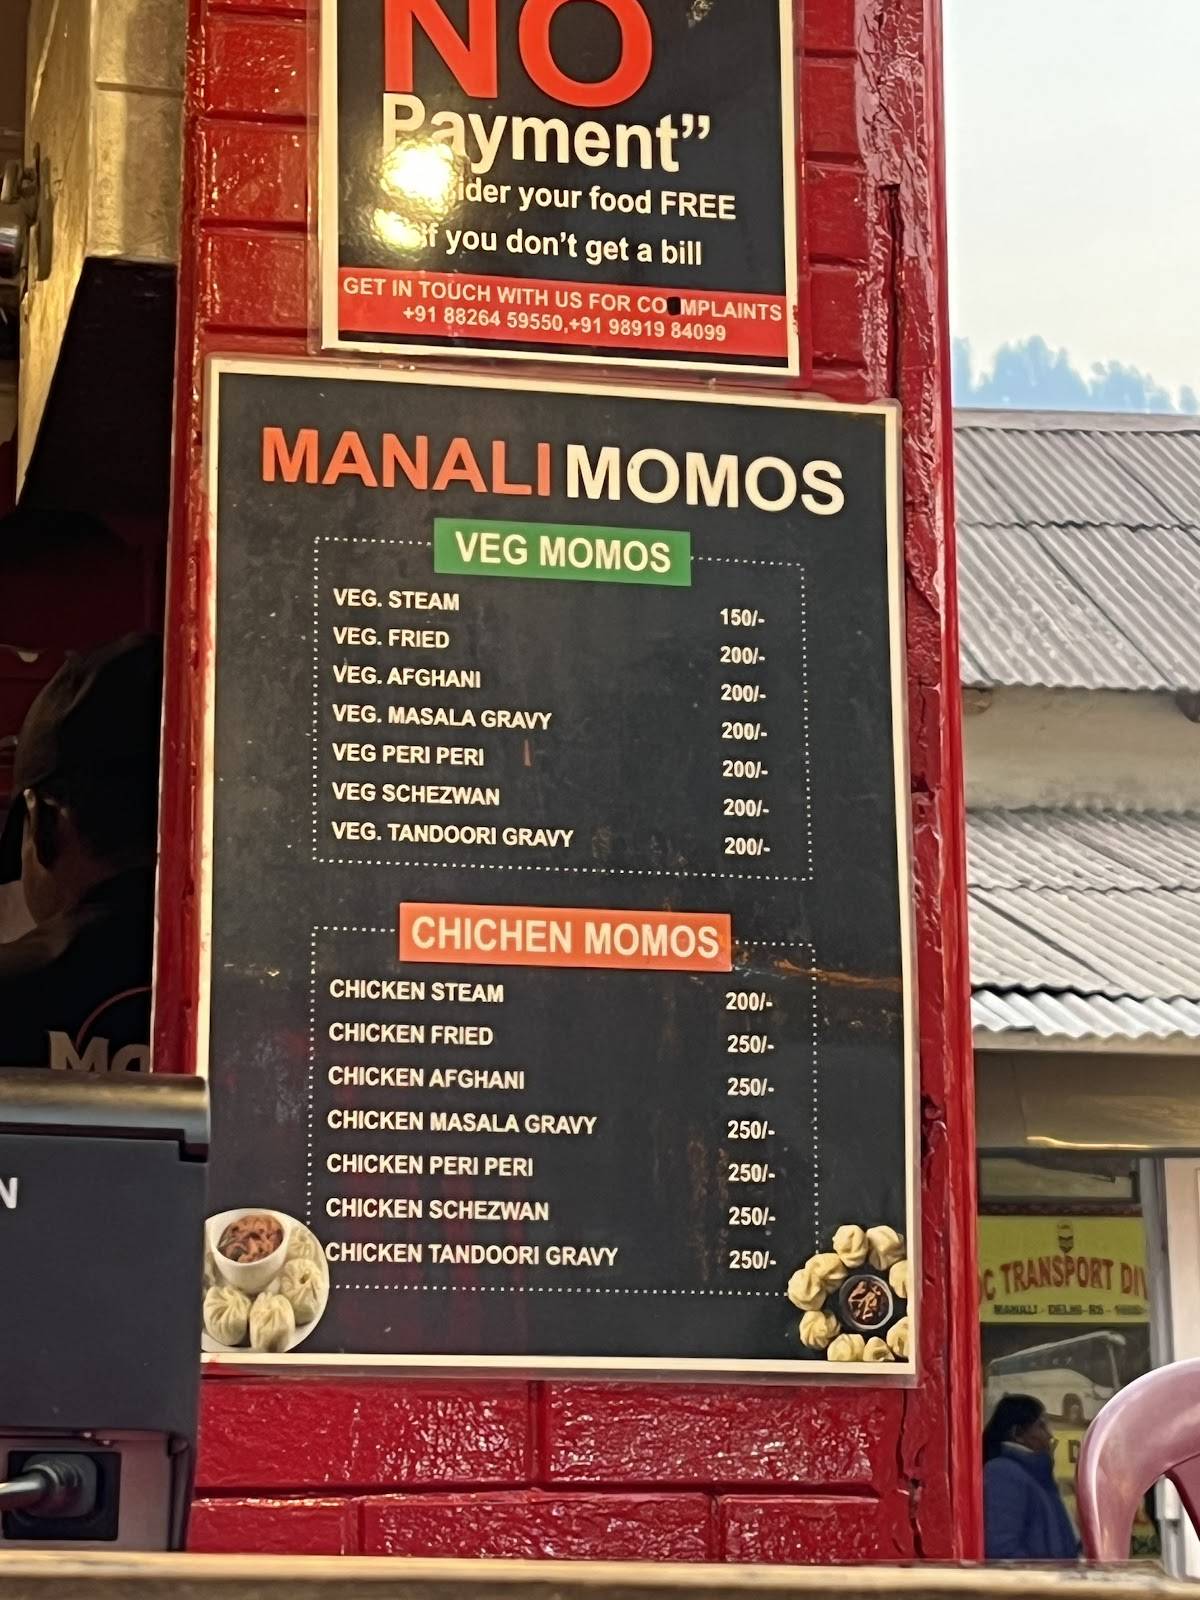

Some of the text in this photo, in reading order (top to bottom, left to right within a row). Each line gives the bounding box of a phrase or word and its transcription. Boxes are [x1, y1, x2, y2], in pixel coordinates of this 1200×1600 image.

[383, 0, 653, 107] NO
[458, 177, 737, 220] ider your food FREE
[445, 229, 497, 255] you
[585, 237, 630, 266] get
[636, 242, 653, 263] a
[661, 238, 702, 266] bill
[343, 276, 386, 297] GET
[392, 277, 412, 298] IN
[420, 280, 492, 302] TOUCH
[496, 285, 549, 307] WITH
[555, 290, 583, 309] US
[588, 292, 631, 313] FOR
[402, 304, 436, 323] +91
[443, 306, 502, 330] 88264
[608, 318, 665, 338] 98919
[670, 321, 727, 342] 84099
[262, 426, 845, 516] MANALI MOMOS
[454, 530, 672, 574] VEG MOMOS
[332, 587, 765, 627] VEG. STEAM 150/-
[332, 626, 766, 665] VEG. FRIED 200/-
[332, 664, 767, 703] VEG. AFGHANI 200/-
[331, 703, 768, 741] VEG. MASALA GRAVY 200/-
[331, 742, 769, 779] VEG PERI PERI 200/-
[331, 781, 770, 817] VEG SCHEZWAN 200/-
[331, 821, 771, 856] VEG. TANDOORI GRAVY 200/-
[411, 915, 720, 959] CHICHEN MOMOS
[329, 978, 773, 1011] CHICKEN STEAM 200/-
[328, 1022, 775, 1054] CHICKEN FRIED 250/-
[328, 1065, 775, 1097] CHICKEN AFGHANI 250/-
[327, 1109, 776, 1140] CHICKEN MASALA GRAVY 250/-
[326, 1153, 776, 1183] CHICKEN PERI PERI 250/-
[325, 1197, 776, 1226] CHICKEN SCHEZWAN 250/-
[325, 1241, 777, 1270] CHICKEN TANDOORI GRAVY 250/-
[1000, 1255, 1114, 1295] TRANSPORT
